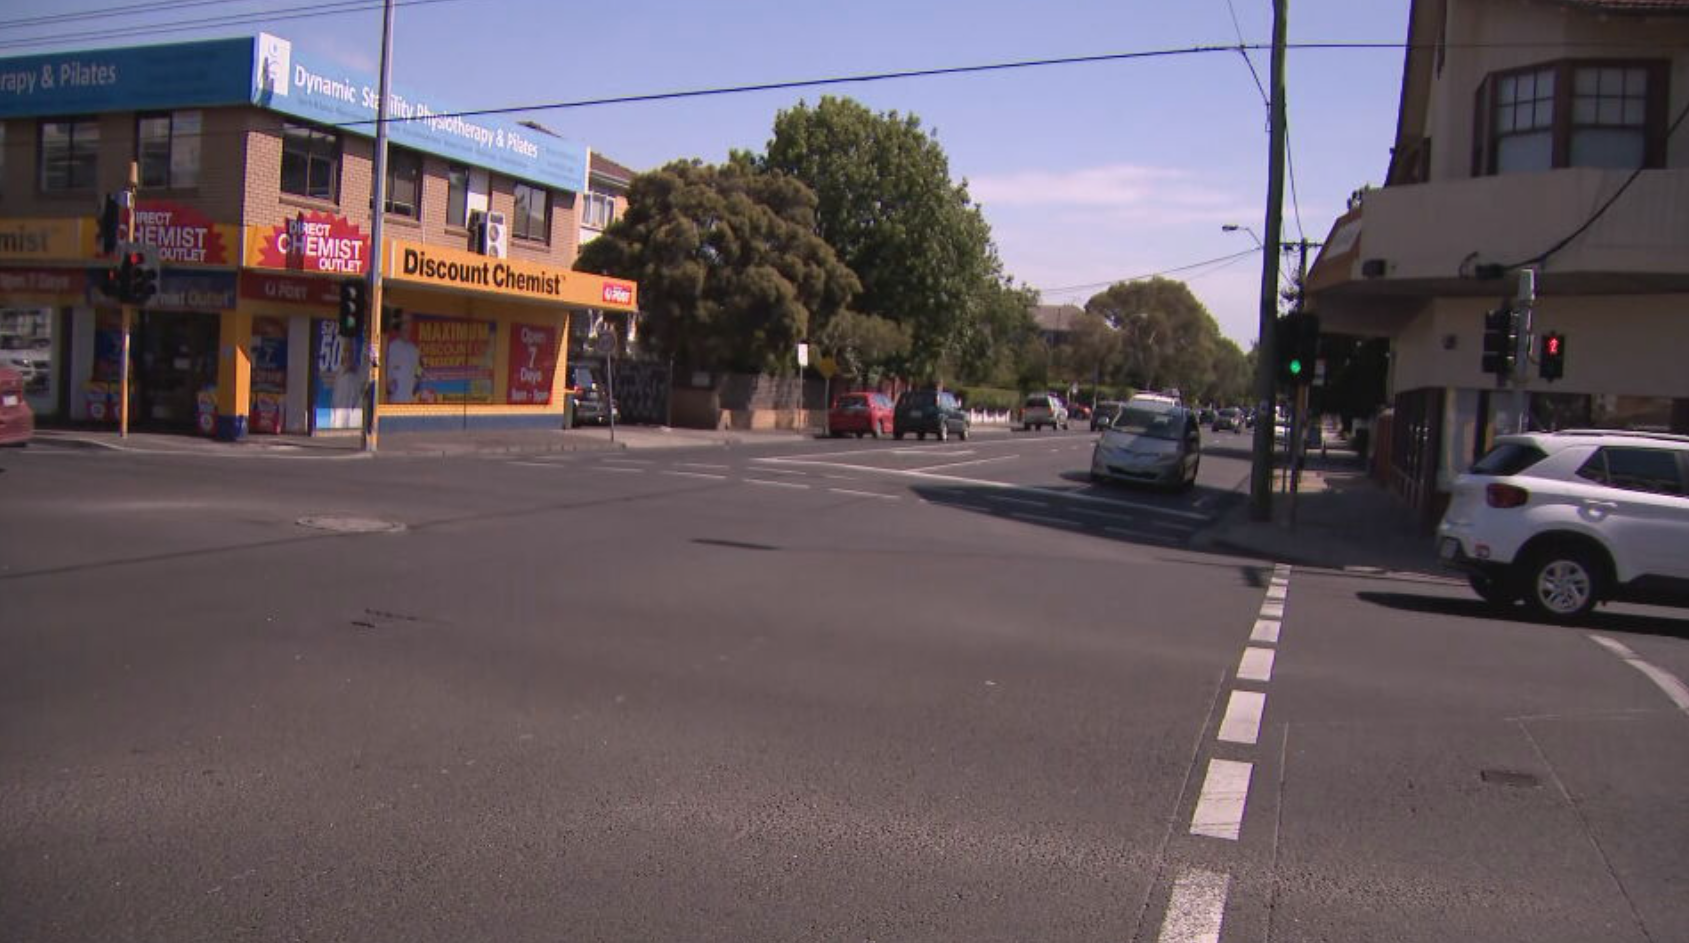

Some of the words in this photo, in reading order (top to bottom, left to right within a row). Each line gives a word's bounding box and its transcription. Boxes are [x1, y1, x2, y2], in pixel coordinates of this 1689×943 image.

[0, 71, 36, 94] rapy
[41, 64, 54, 88] &
[60, 60, 116, 87] Pilates
[294, 65, 356, 103] Dynamic
[361, 86, 413, 126] Staility
[416, 102, 493, 149] Physiotherapy
[495, 128, 505, 148] &
[507, 131, 538, 159] Pilates
[133, 211, 172, 226] IRECT
[289, 221, 332, 236] DIRECT
[117, 224, 208, 249] CHEMIST
[277, 233, 363, 260] CHEMIST
[158, 248, 207, 262] OUTLET
[318, 257, 362, 273] OUTLET
[403, 247, 490, 287] Discount
[492, 262, 561, 295] Chemist
[521, 327, 546, 344] Open
[528, 346, 537, 368] 7
[520, 366, 543, 384] Days
